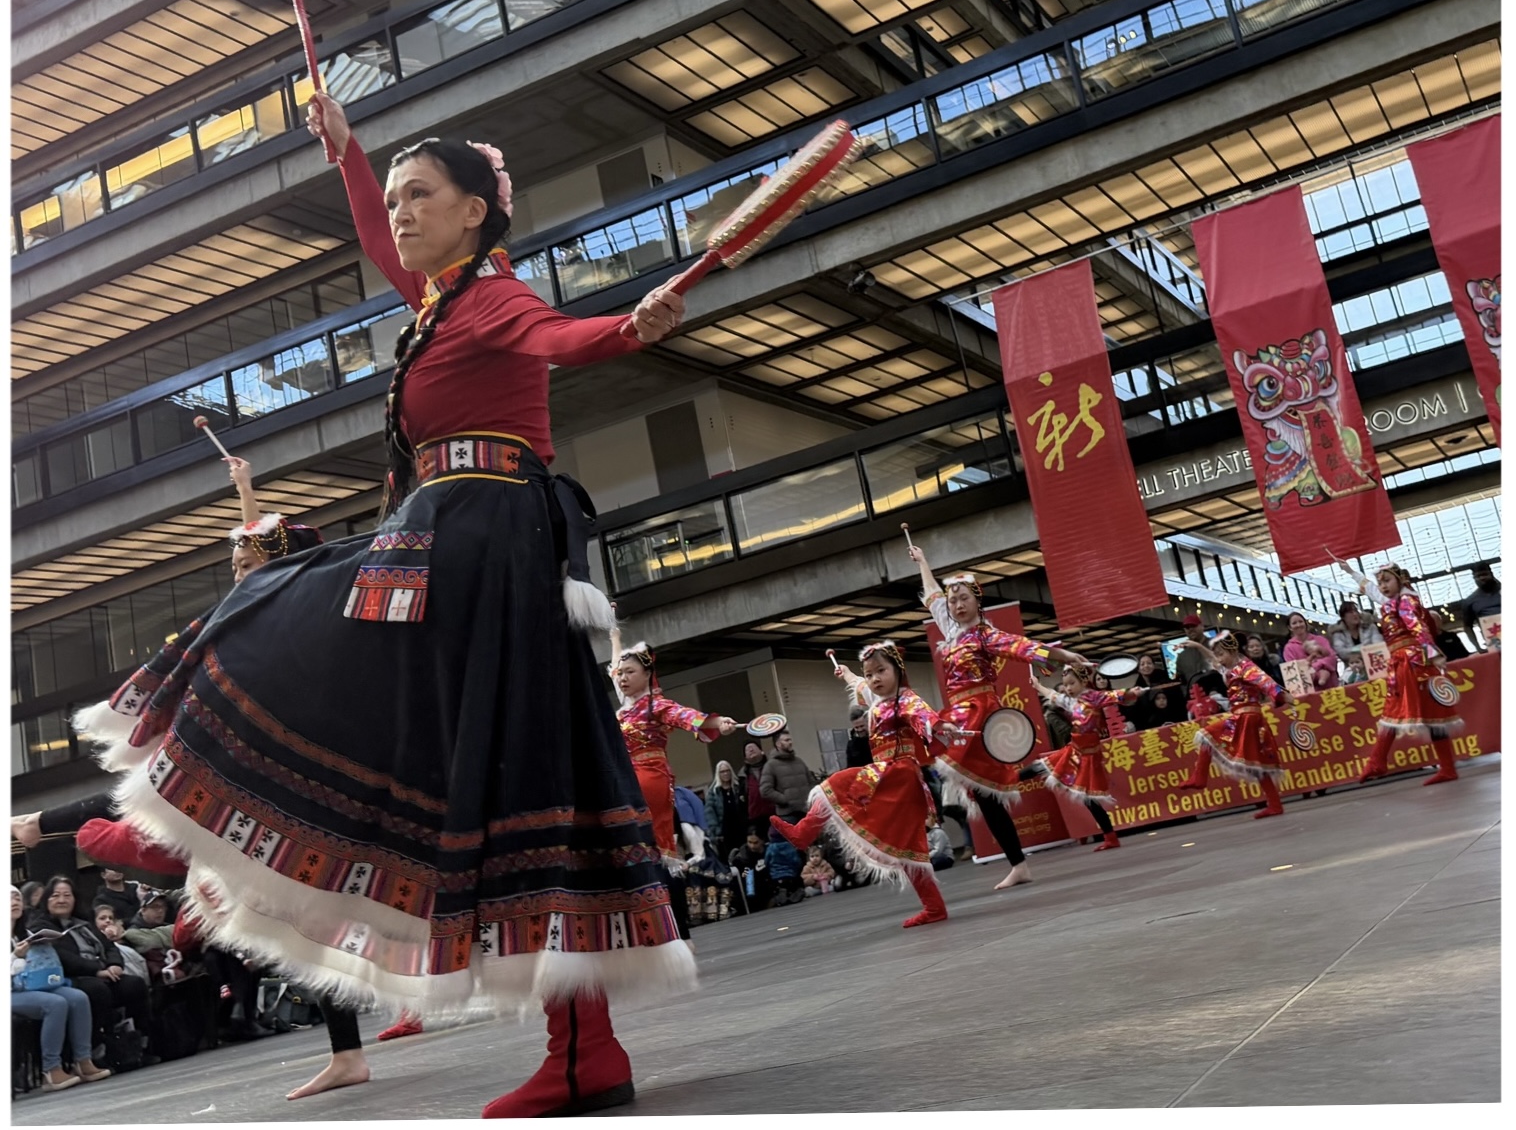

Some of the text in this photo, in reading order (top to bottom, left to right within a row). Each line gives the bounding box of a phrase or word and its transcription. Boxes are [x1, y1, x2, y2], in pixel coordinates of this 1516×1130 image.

[1137, 474, 1165, 500] LL
[1166, 449, 1254, 490] THEATE
[1166, 785, 1232, 815] Center
